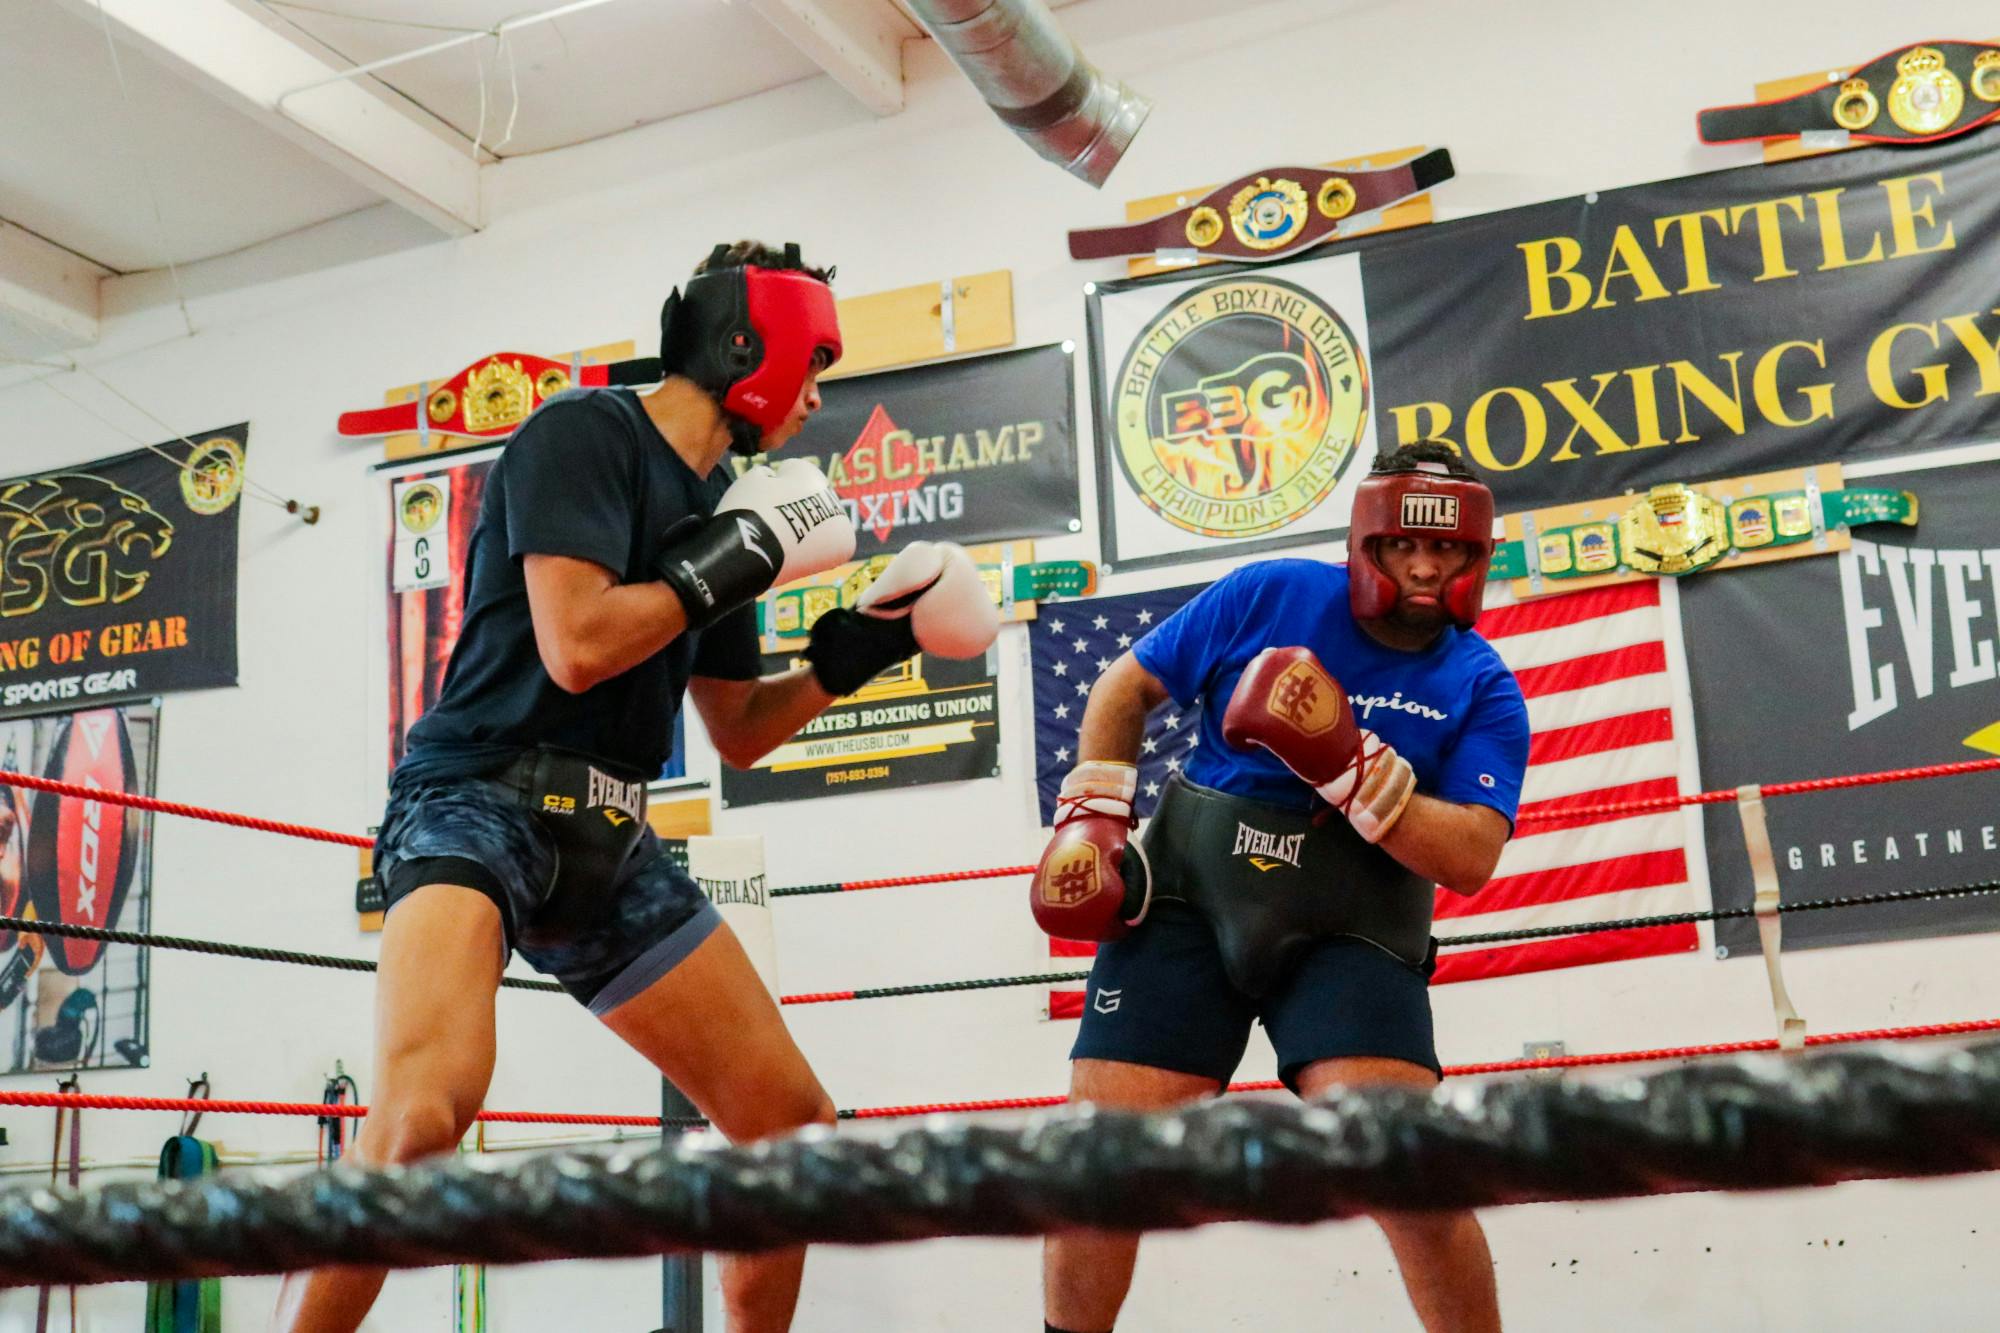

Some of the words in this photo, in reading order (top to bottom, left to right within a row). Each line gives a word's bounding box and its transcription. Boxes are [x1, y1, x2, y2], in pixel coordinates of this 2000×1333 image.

[1517, 171, 1957, 321] BATTLE
[1126, 303, 1204, 398] BATTLE
[1212, 288, 1306, 323] BOXING
[1309, 315, 1350, 369] GYM
[1388, 338, 1836, 473] BOXING
[1141, 463, 1289, 526] CHAMPIONS
[1293, 434, 1348, 500] RISE
[1405, 497, 1456, 525] TITLE
[49, 630, 92, 665] OF
[100, 616, 188, 657] GEAR
[4, 675, 83, 706] SPORTS
[83, 668, 137, 695] GEAR
[796, 711, 857, 736] TATES
[861, 703, 931, 727] BOXING
[935, 695, 993, 719] UNION
[805, 733, 910, 757] WWW.THEUSBU.COM
[543, 805, 576, 815] FOAM
[586, 765, 641, 824] EVERLAST
[1232, 821, 1305, 868] EVERLAST
[1787, 826, 1997, 871] GREATNE
